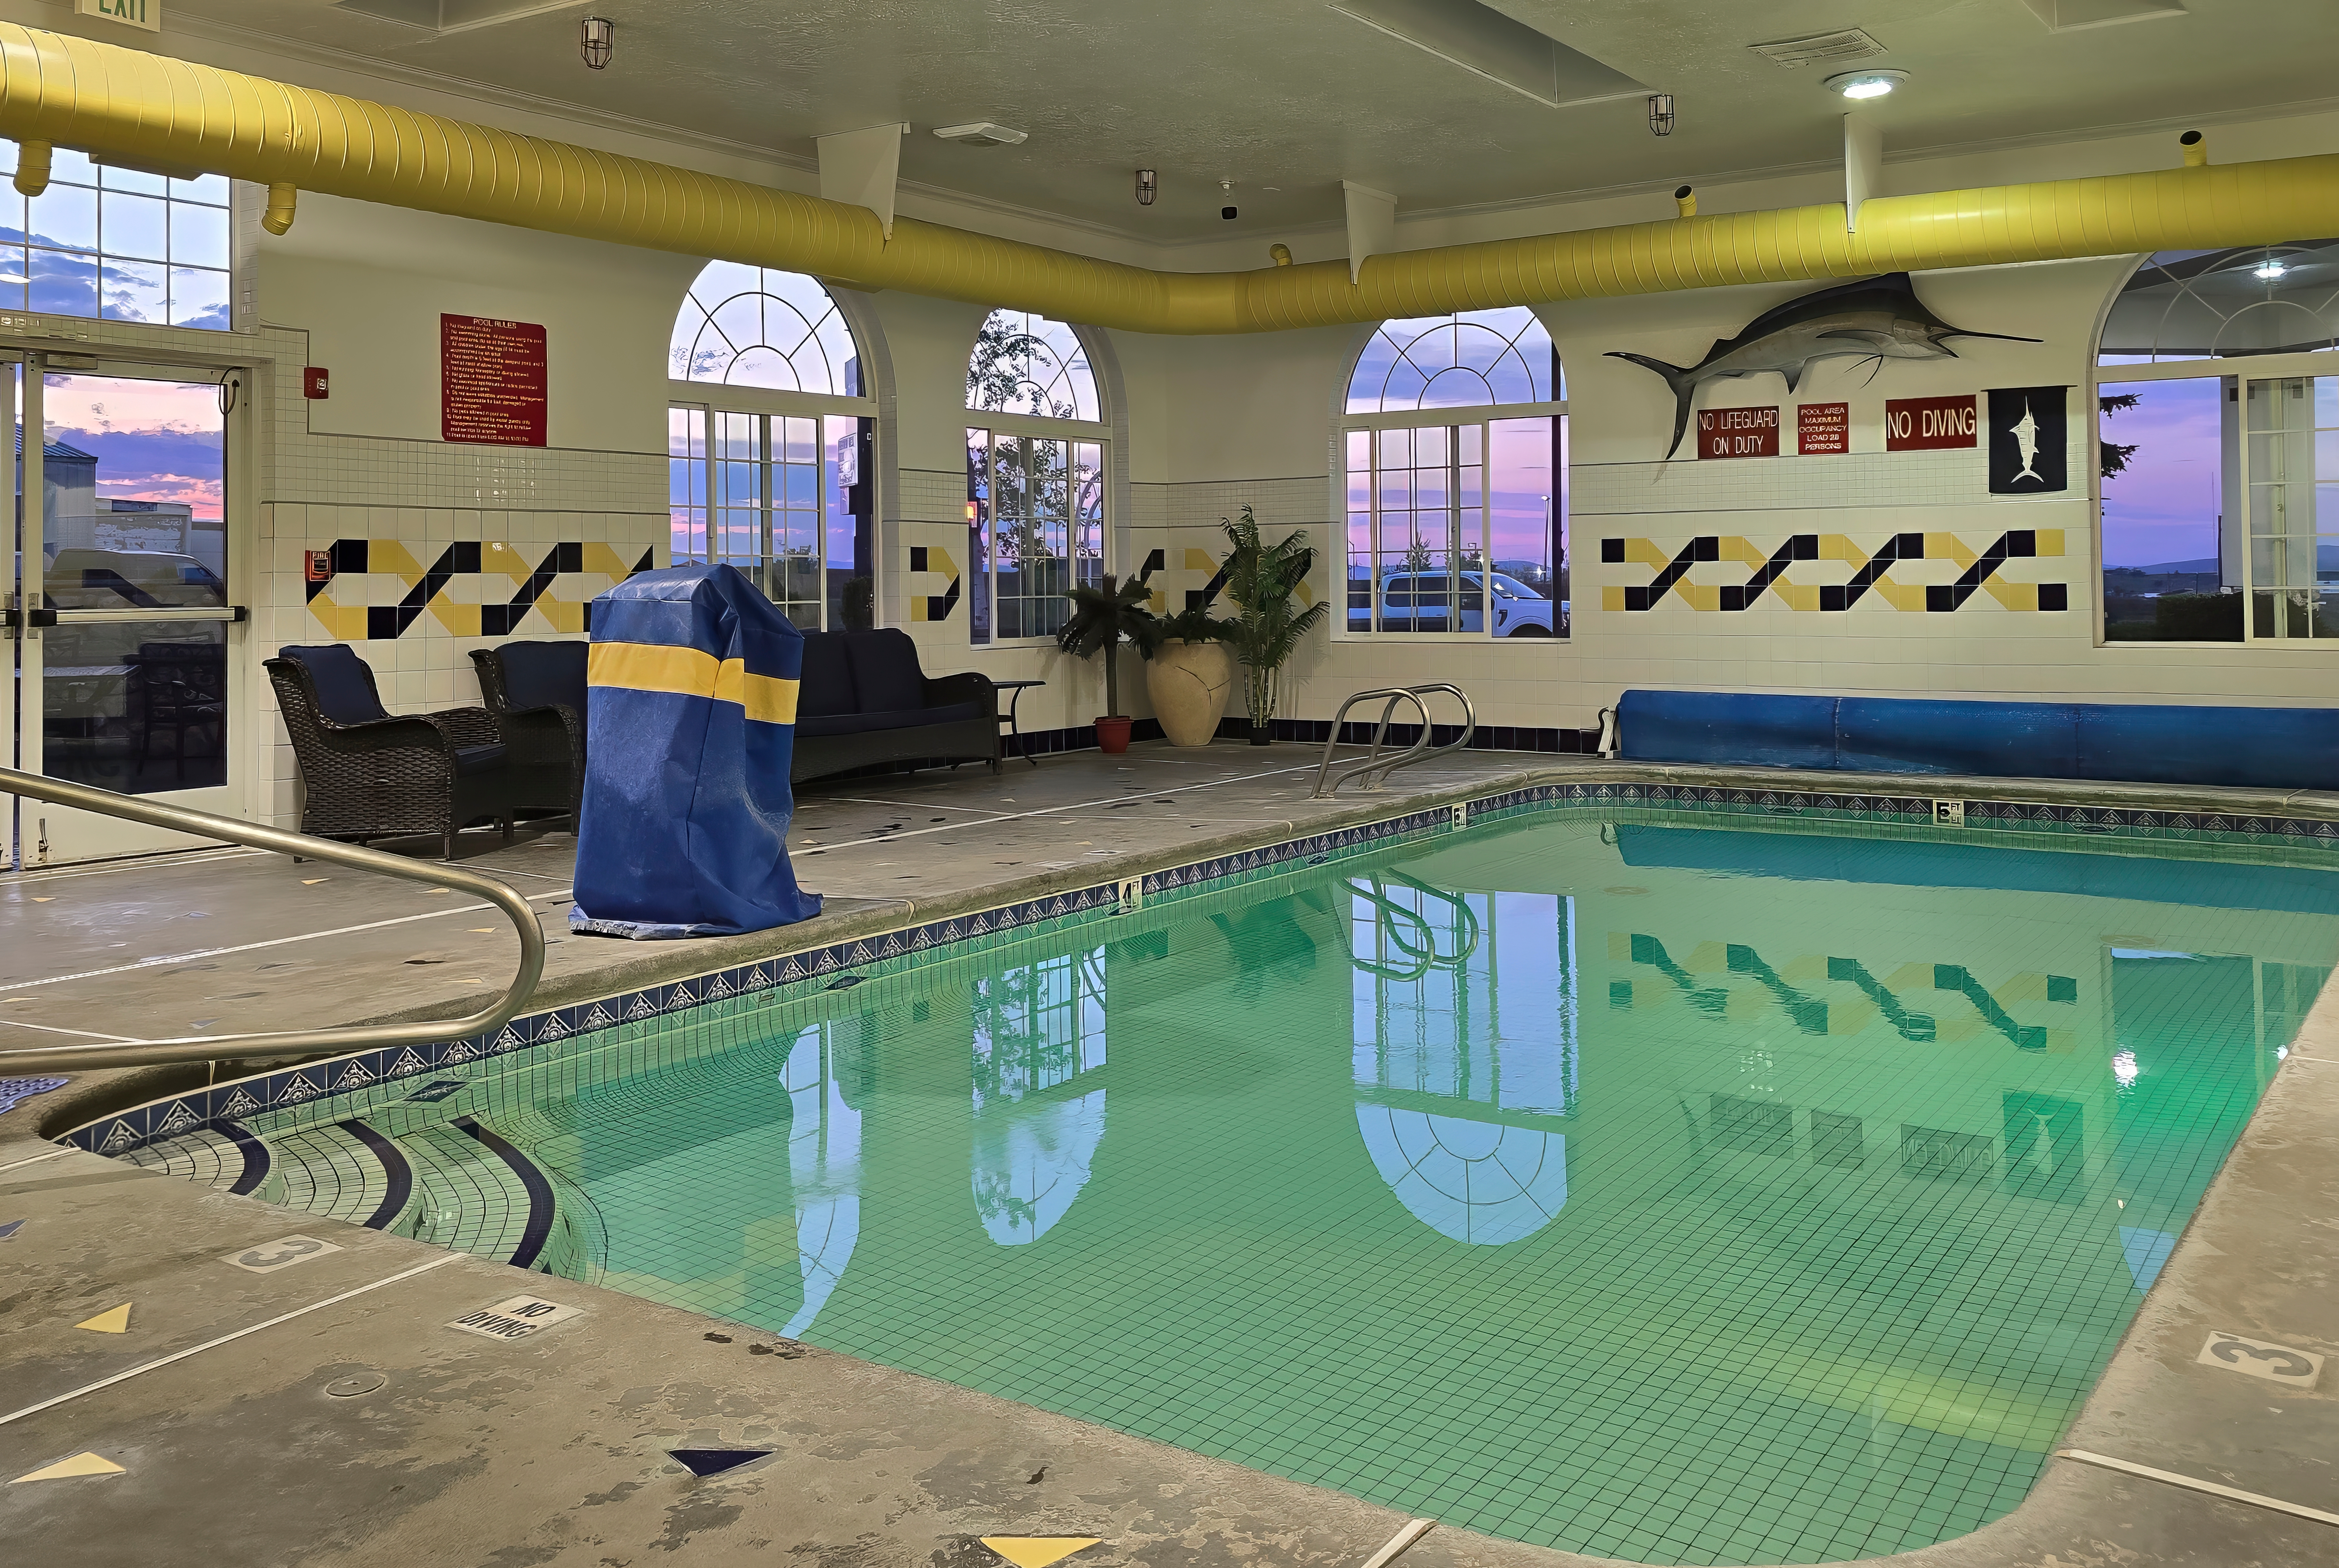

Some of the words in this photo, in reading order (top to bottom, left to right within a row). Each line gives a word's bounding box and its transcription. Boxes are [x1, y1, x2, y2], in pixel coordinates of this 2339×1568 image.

[473, 318, 493, 326] POOL
[1699, 413, 1714, 430] NO
[1721, 410, 1778, 429] LIFEGUARD
[1799, 424, 1847, 433] OCCUPANCY
[1888, 411, 1911, 439] NO
[1922, 407, 1975, 437] DIVING
[1713, 437, 1728, 454] ON
[1736, 435, 1763, 453] DUTY
[238, 1240, 323, 1267] 3
[510, 1302, 557, 1318] NO
[456, 1312, 538, 1337] DIVING
[2210, 1341, 2314, 1377] 3
